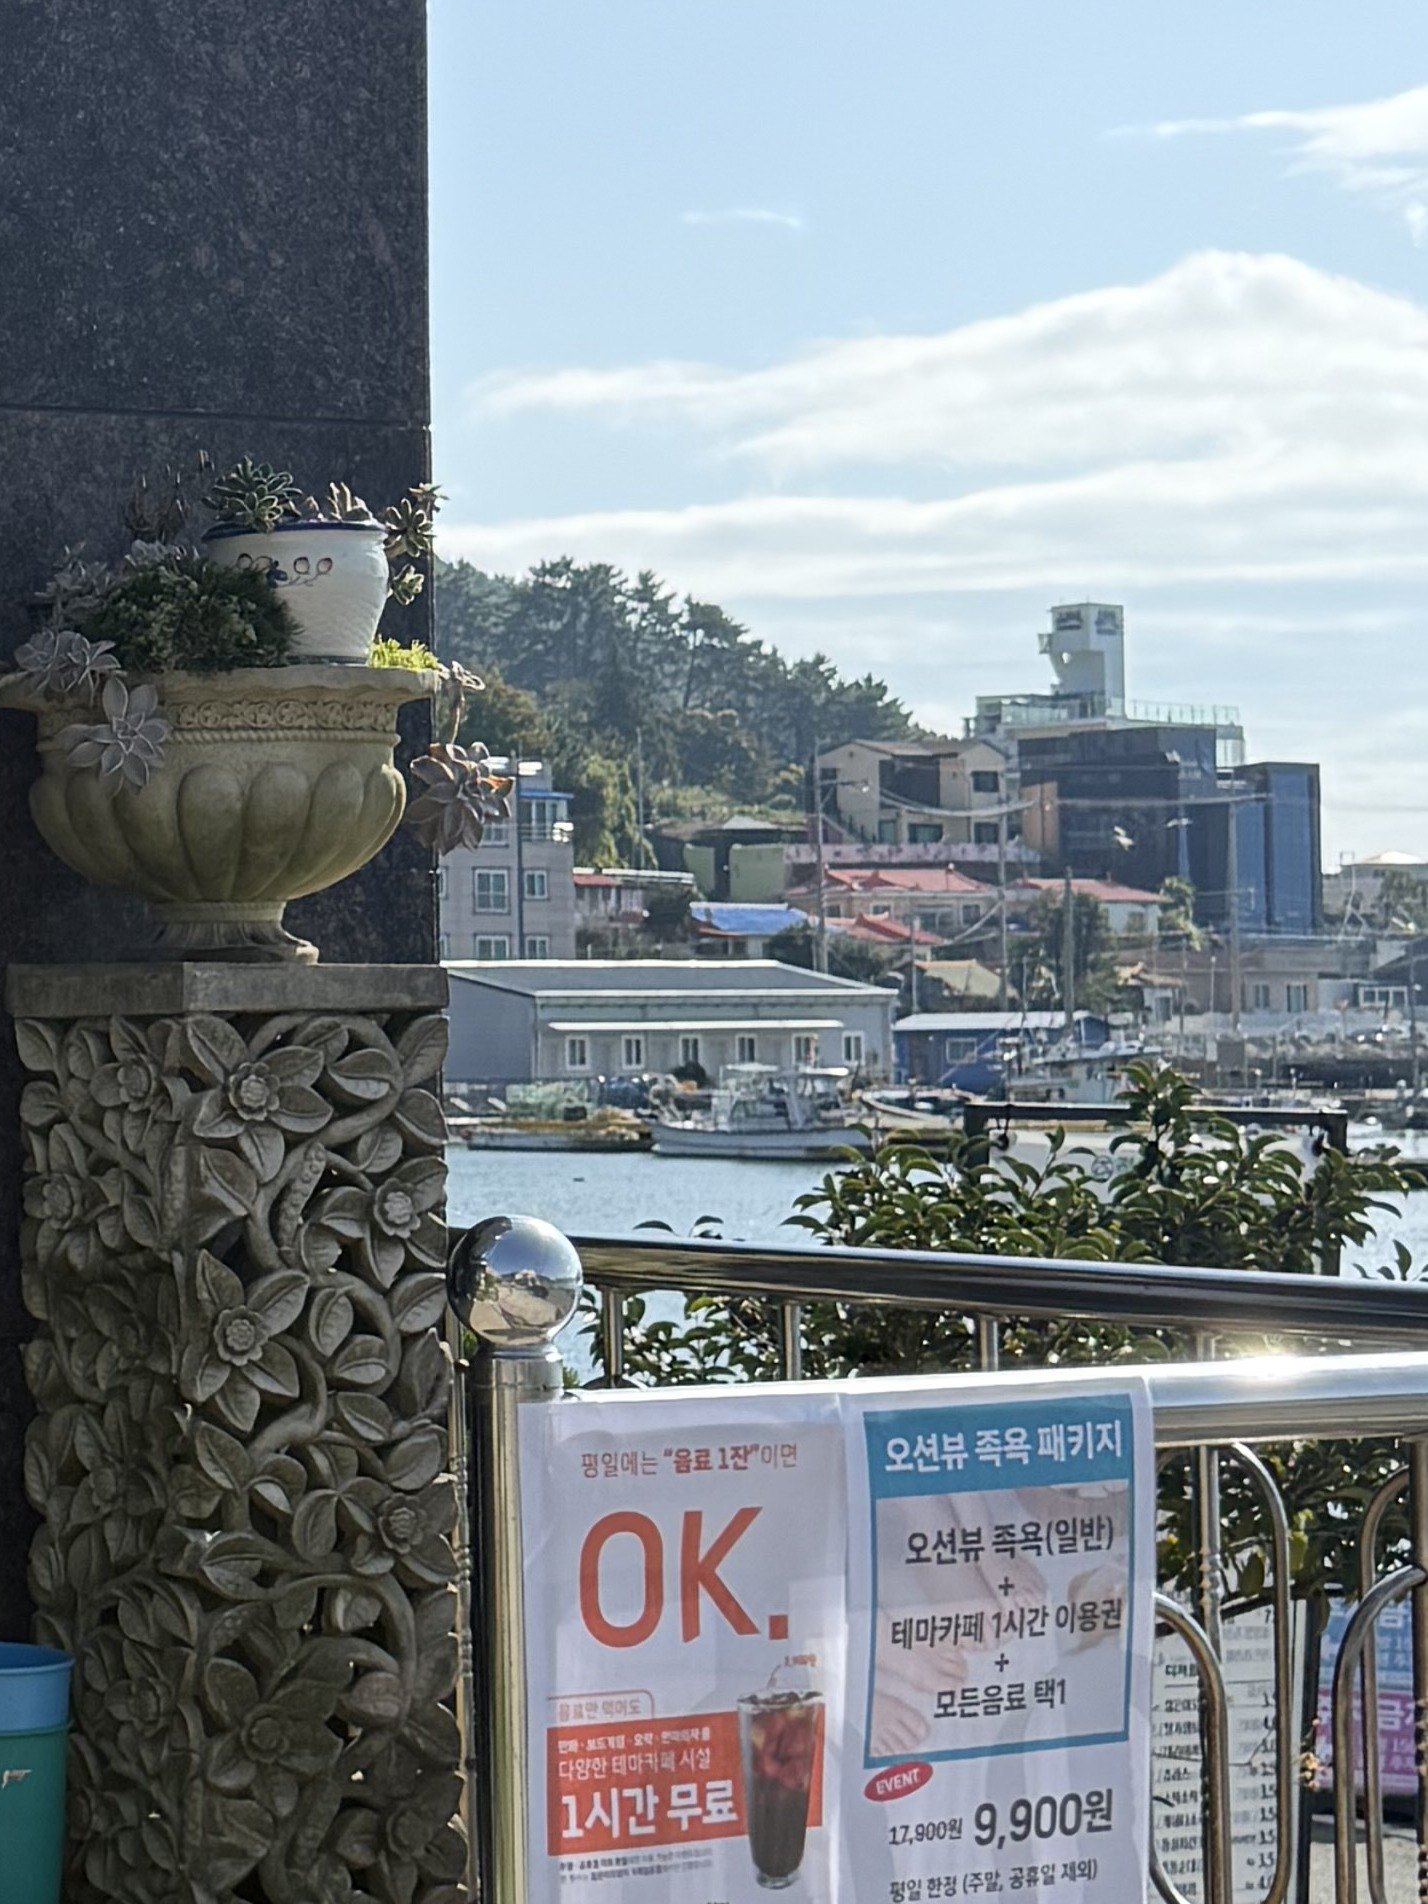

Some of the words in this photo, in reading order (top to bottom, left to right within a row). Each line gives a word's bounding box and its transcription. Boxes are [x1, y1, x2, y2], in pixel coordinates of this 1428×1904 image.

[581, 1450, 658, 1479] 평일에는
[884, 1432, 969, 1474] 오션뷰
[974, 1427, 1032, 1468] 족욕
[1037, 1419, 1122, 1463] 패키지
[905, 1526, 985, 1565] 오션뷰
[991, 1515, 1114, 1560] 족욕(일반)
[579, 1506, 789, 1649] OK.
[891, 1611, 985, 1650] 테마카페
[991, 1605, 1049, 1640] 1시간
[1055, 1598, 1122, 1634] 이용권
[933, 1682, 1027, 1720] 모든음료
[1034, 1678, 1066, 1710] 택1
[558, 1757, 607, 1782] 다양한
[611, 1751, 676, 1776] 테마카페
[679, 1747, 711, 1773] 시설
[876, 1768, 920, 1795] EVENT
[561, 1783, 660, 1839] 1시간
[666, 1779, 739, 1832] 무료
[888, 1817, 963, 1846] 17,900원
[974, 1788, 1113, 1850] 9,900원
[889, 1878, 921, 1904] 평일
[926, 1874, 958, 1899] 한정
[1009, 1863, 1056, 1890] 공휴일
[1061, 1858, 1098, 1882] 제외)
